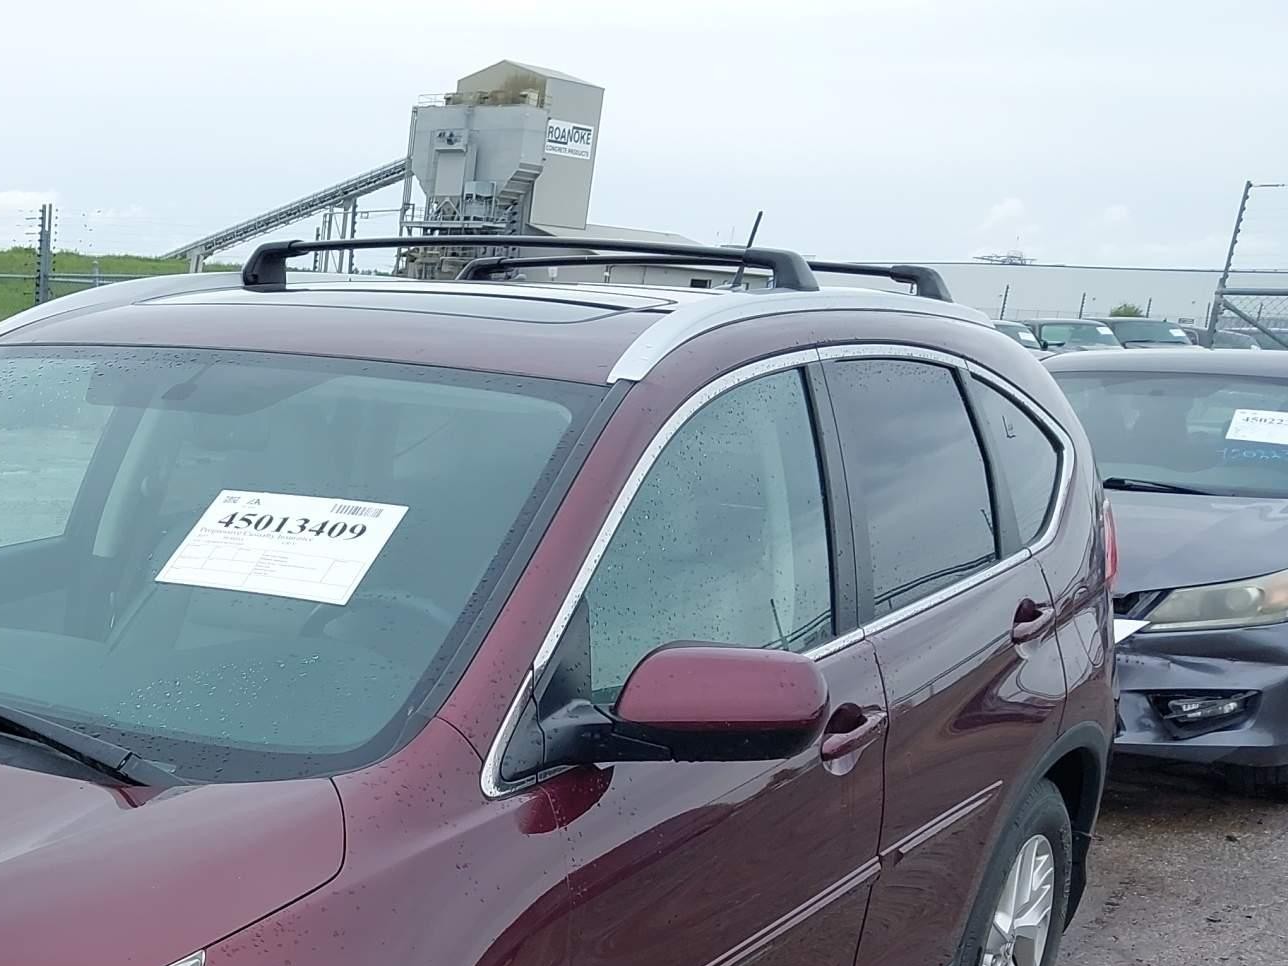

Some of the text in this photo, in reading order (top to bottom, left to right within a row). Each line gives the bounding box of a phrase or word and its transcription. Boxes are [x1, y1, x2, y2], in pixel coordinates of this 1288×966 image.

[547, 126, 592, 145] ROANOKE
[545, 144, 567, 154] CONCRETE
[217, 511, 368, 541] 45013409
